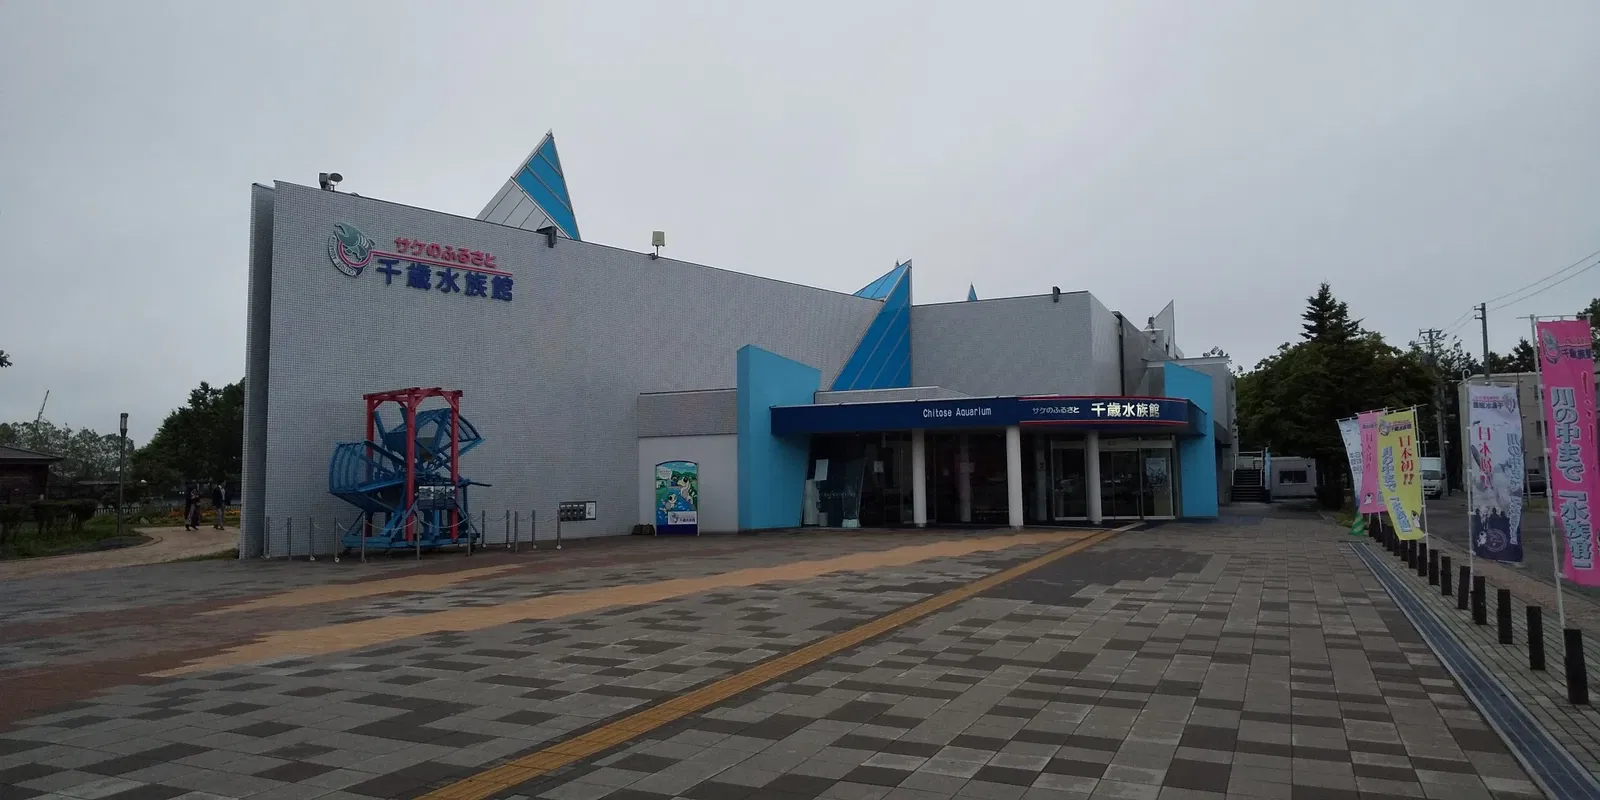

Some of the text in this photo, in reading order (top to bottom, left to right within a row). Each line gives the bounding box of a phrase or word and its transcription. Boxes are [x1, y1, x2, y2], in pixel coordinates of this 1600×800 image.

[394, 237, 497, 268] サケのふるさと
[376, 258, 514, 302] 千歳水族館
[922, 407, 992, 418] Chitose Aquarium
[1032, 402, 1160, 418] サケのふるさと 千歳水族館
[1551, 388, 1584, 482] 川の中まで
